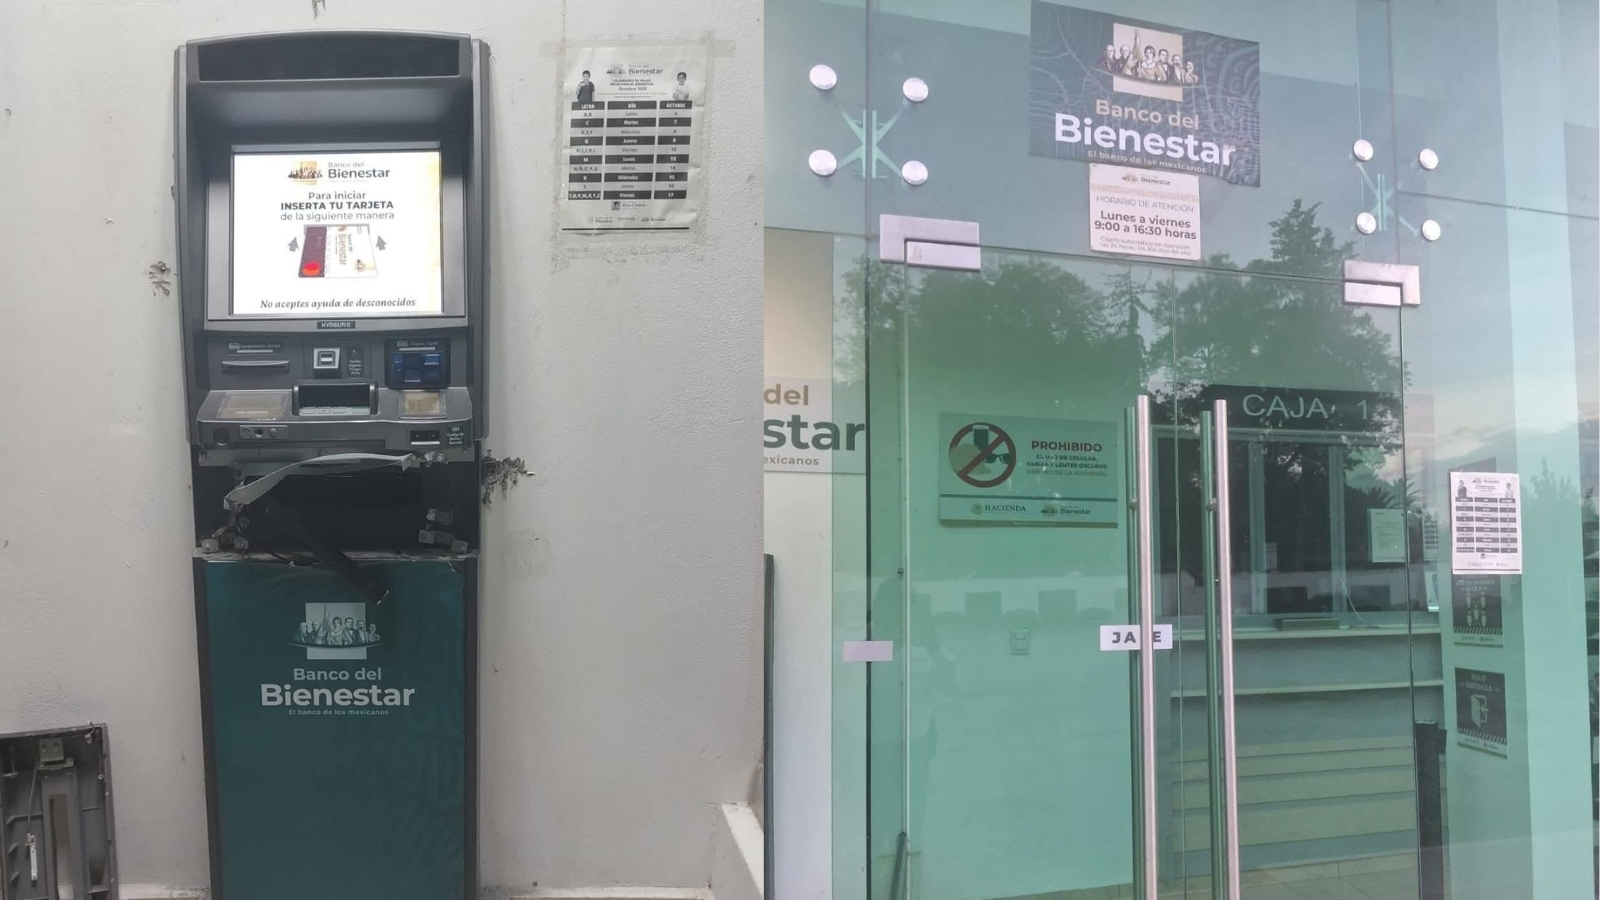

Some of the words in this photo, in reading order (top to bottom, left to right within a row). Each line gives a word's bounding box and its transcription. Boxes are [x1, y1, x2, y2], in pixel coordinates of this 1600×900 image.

[1095, 99, 1162, 124] Banco
[1168, 111, 1199, 130] del
[1055, 113, 1236, 166] Bienestar
[1099, 152, 1127, 162] banco
[1130, 155, 1141, 163] de
[1159, 160, 1207, 173] mexicanos
[328, 168, 391, 179] Bienestar
[1140, 176, 1171, 186] Bienestar
[308, 192, 332, 200] Para
[334, 190, 366, 200] iniciar
[280, 202, 327, 211] INSERTA
[329, 201, 343, 210] TU
[346, 201, 394, 209] TARJETA
[1096, 195, 1137, 207] HORARIO
[1138, 200, 1150, 208] DE
[1152, 200, 1194, 213] ATENCIÓN
[280, 212, 293, 221] de
[295, 212, 304, 221] la
[306, 212, 353, 222] siguiente
[356, 212, 395, 220] manera
[1100, 210, 1136, 223] Lunes
[1149, 215, 1191, 229] viernes
[1094, 220, 1120, 231] 9:00
[1123, 224, 1130, 233] a
[1134, 224, 1162, 236] 16:30
[1165, 227, 1197, 240] horas
[260, 300, 273, 309] No
[275, 300, 309, 310] aceptes
[311, 299, 341, 310] ayuda
[343, 299, 354, 307] de
[355, 298, 416, 308] desconocidos
[763, 383, 809, 406] del
[1242, 394, 1329, 419] CAJA
[1357, 399, 1369, 420] 1
[1031, 441, 1102, 452] PROHIBIDO
[985, 504, 1027, 512] HACIENDA
[1111, 631, 1162, 644] JAE
[293, 667, 350, 681] Banco
[354, 666, 382, 681] del
[1470, 673, 1487, 681] SOLO
[260, 683, 415, 707] Bienestar
